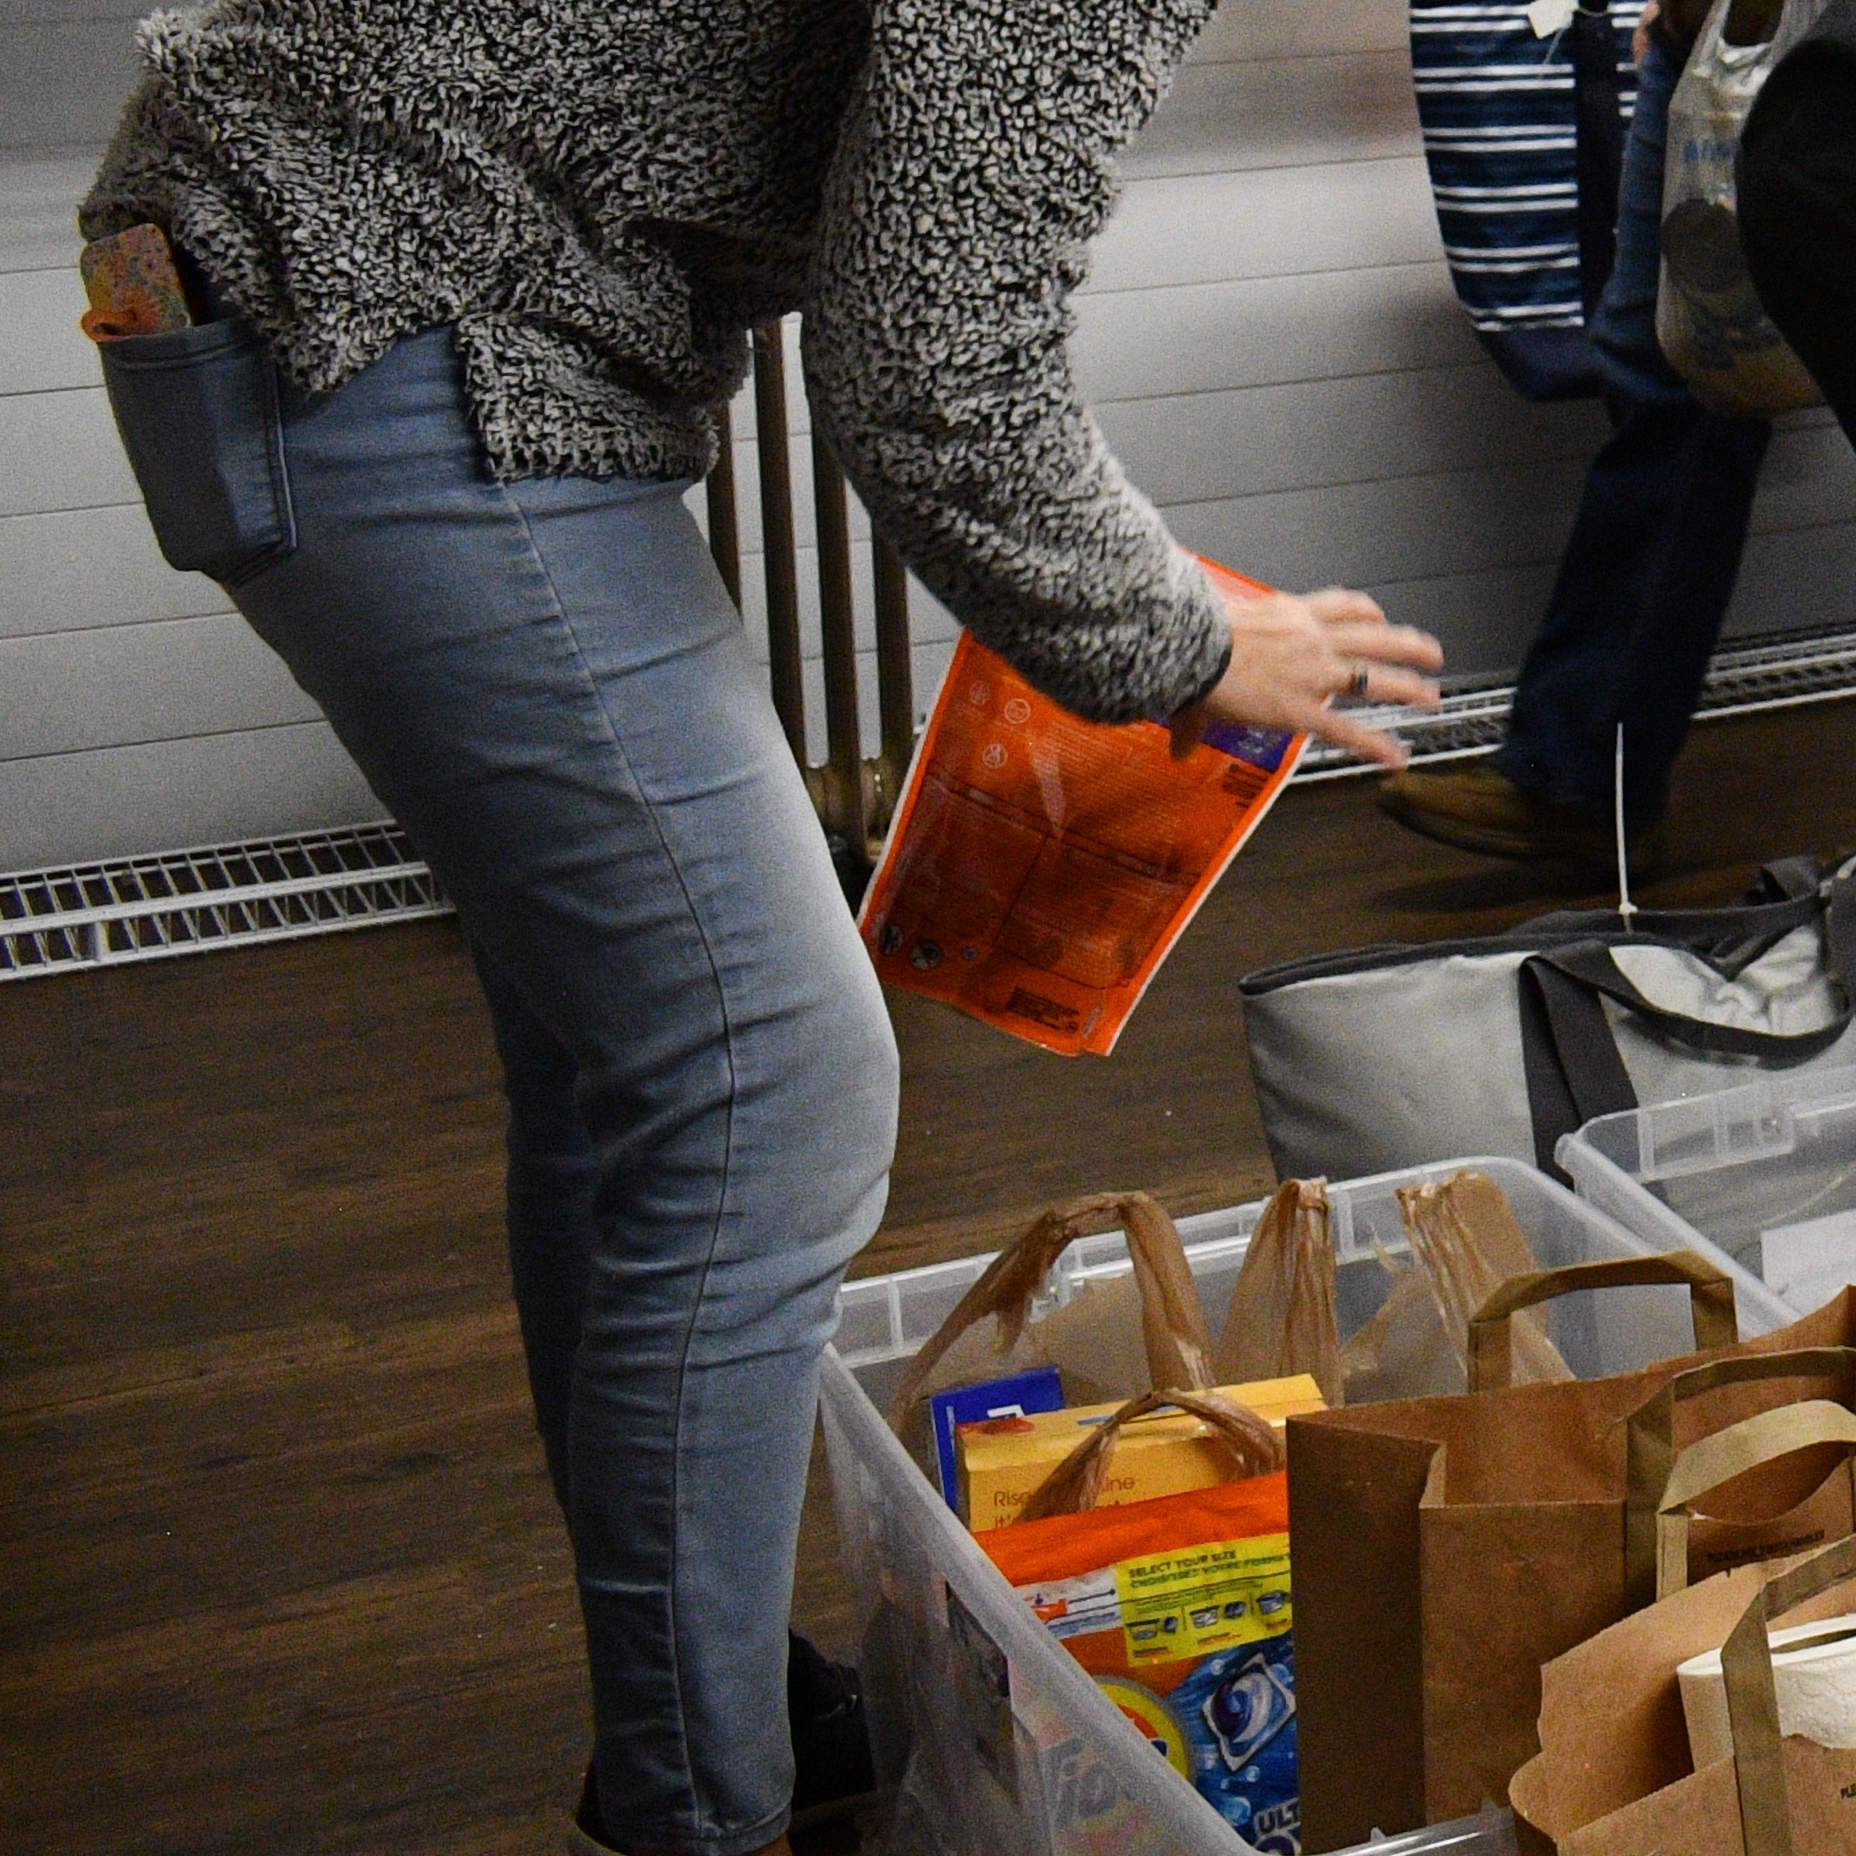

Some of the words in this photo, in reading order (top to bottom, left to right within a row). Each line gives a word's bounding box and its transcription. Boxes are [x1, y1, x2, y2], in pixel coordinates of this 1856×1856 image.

[1129, 1561, 1172, 1579] SELECT
[1175, 1554, 1208, 1569] YOUR
[1211, 1549, 1237, 1563] SIZE
